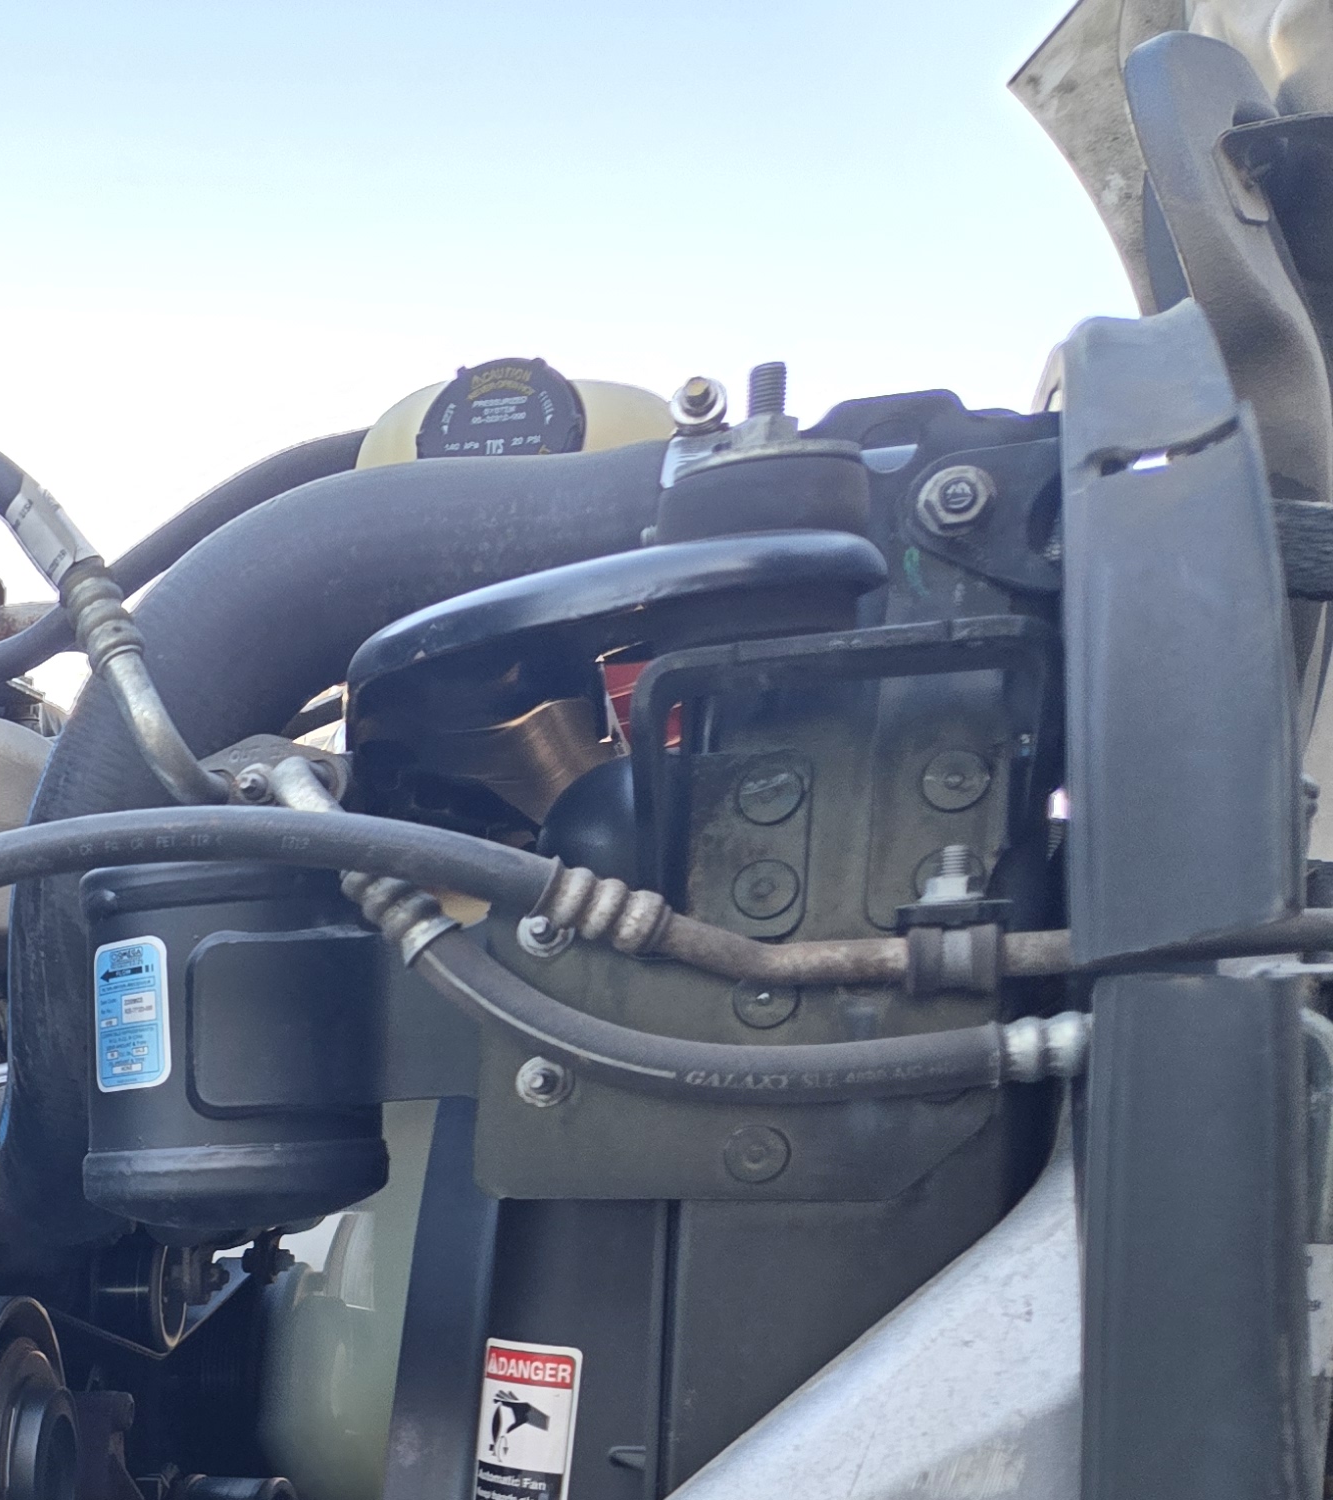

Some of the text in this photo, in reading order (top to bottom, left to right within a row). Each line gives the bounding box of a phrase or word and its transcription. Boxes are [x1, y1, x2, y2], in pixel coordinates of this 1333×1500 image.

[483, 366, 533, 383] CAUTION
[685, 1069, 791, 1090] GALAXY
[497, 1357, 572, 1384] DANGER
[521, 1478, 547, 1491] Fan
